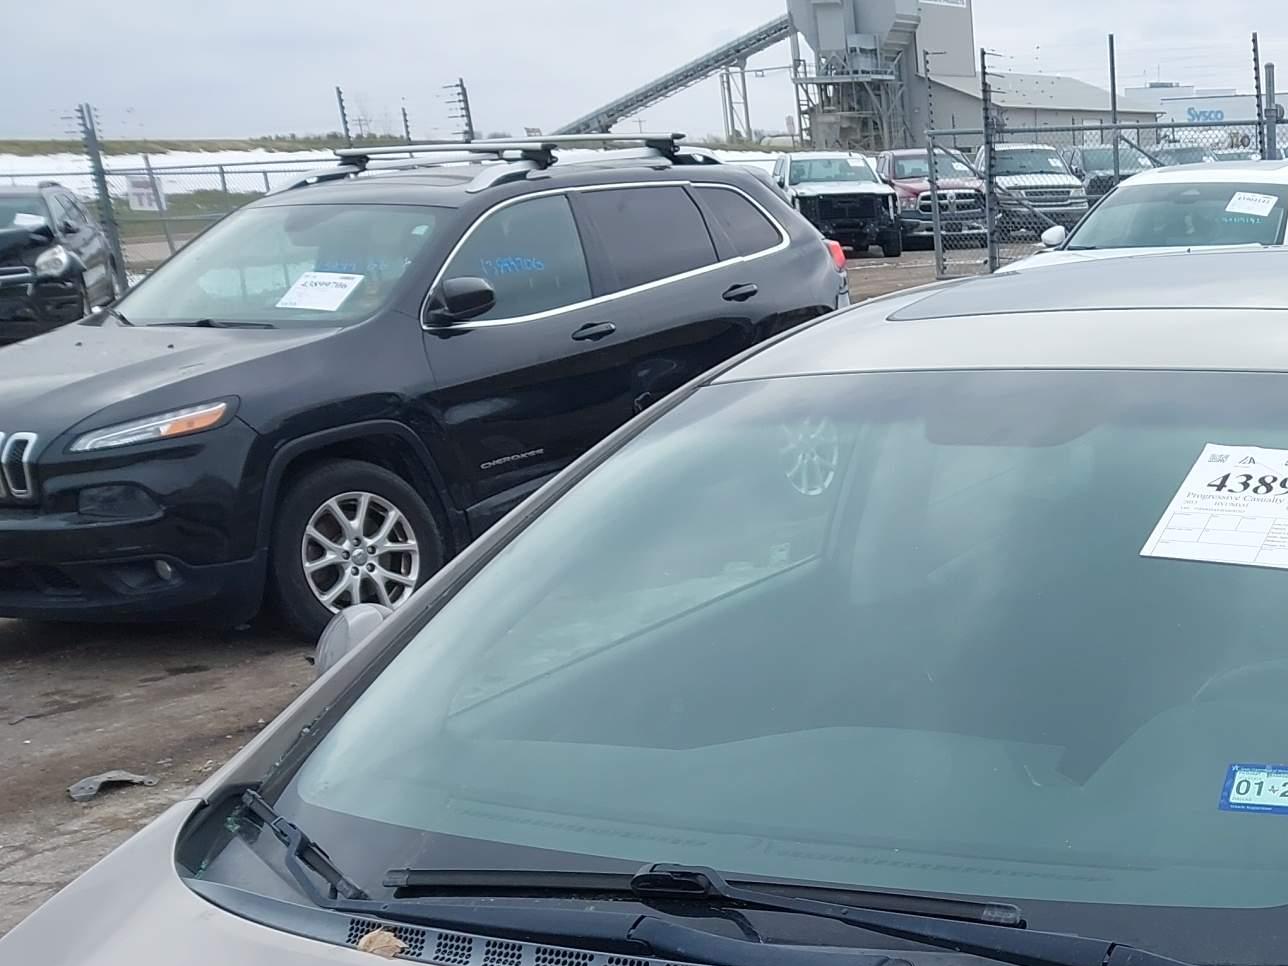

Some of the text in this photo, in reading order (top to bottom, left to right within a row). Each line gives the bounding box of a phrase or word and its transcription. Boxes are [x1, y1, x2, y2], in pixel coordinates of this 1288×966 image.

[1187, 107, 1224, 121] Sysco
[1186, 491, 1241, 502] Progressive
[1243, 494, 1285, 505] Casualty
[1235, 779, 1264, 796] 01
